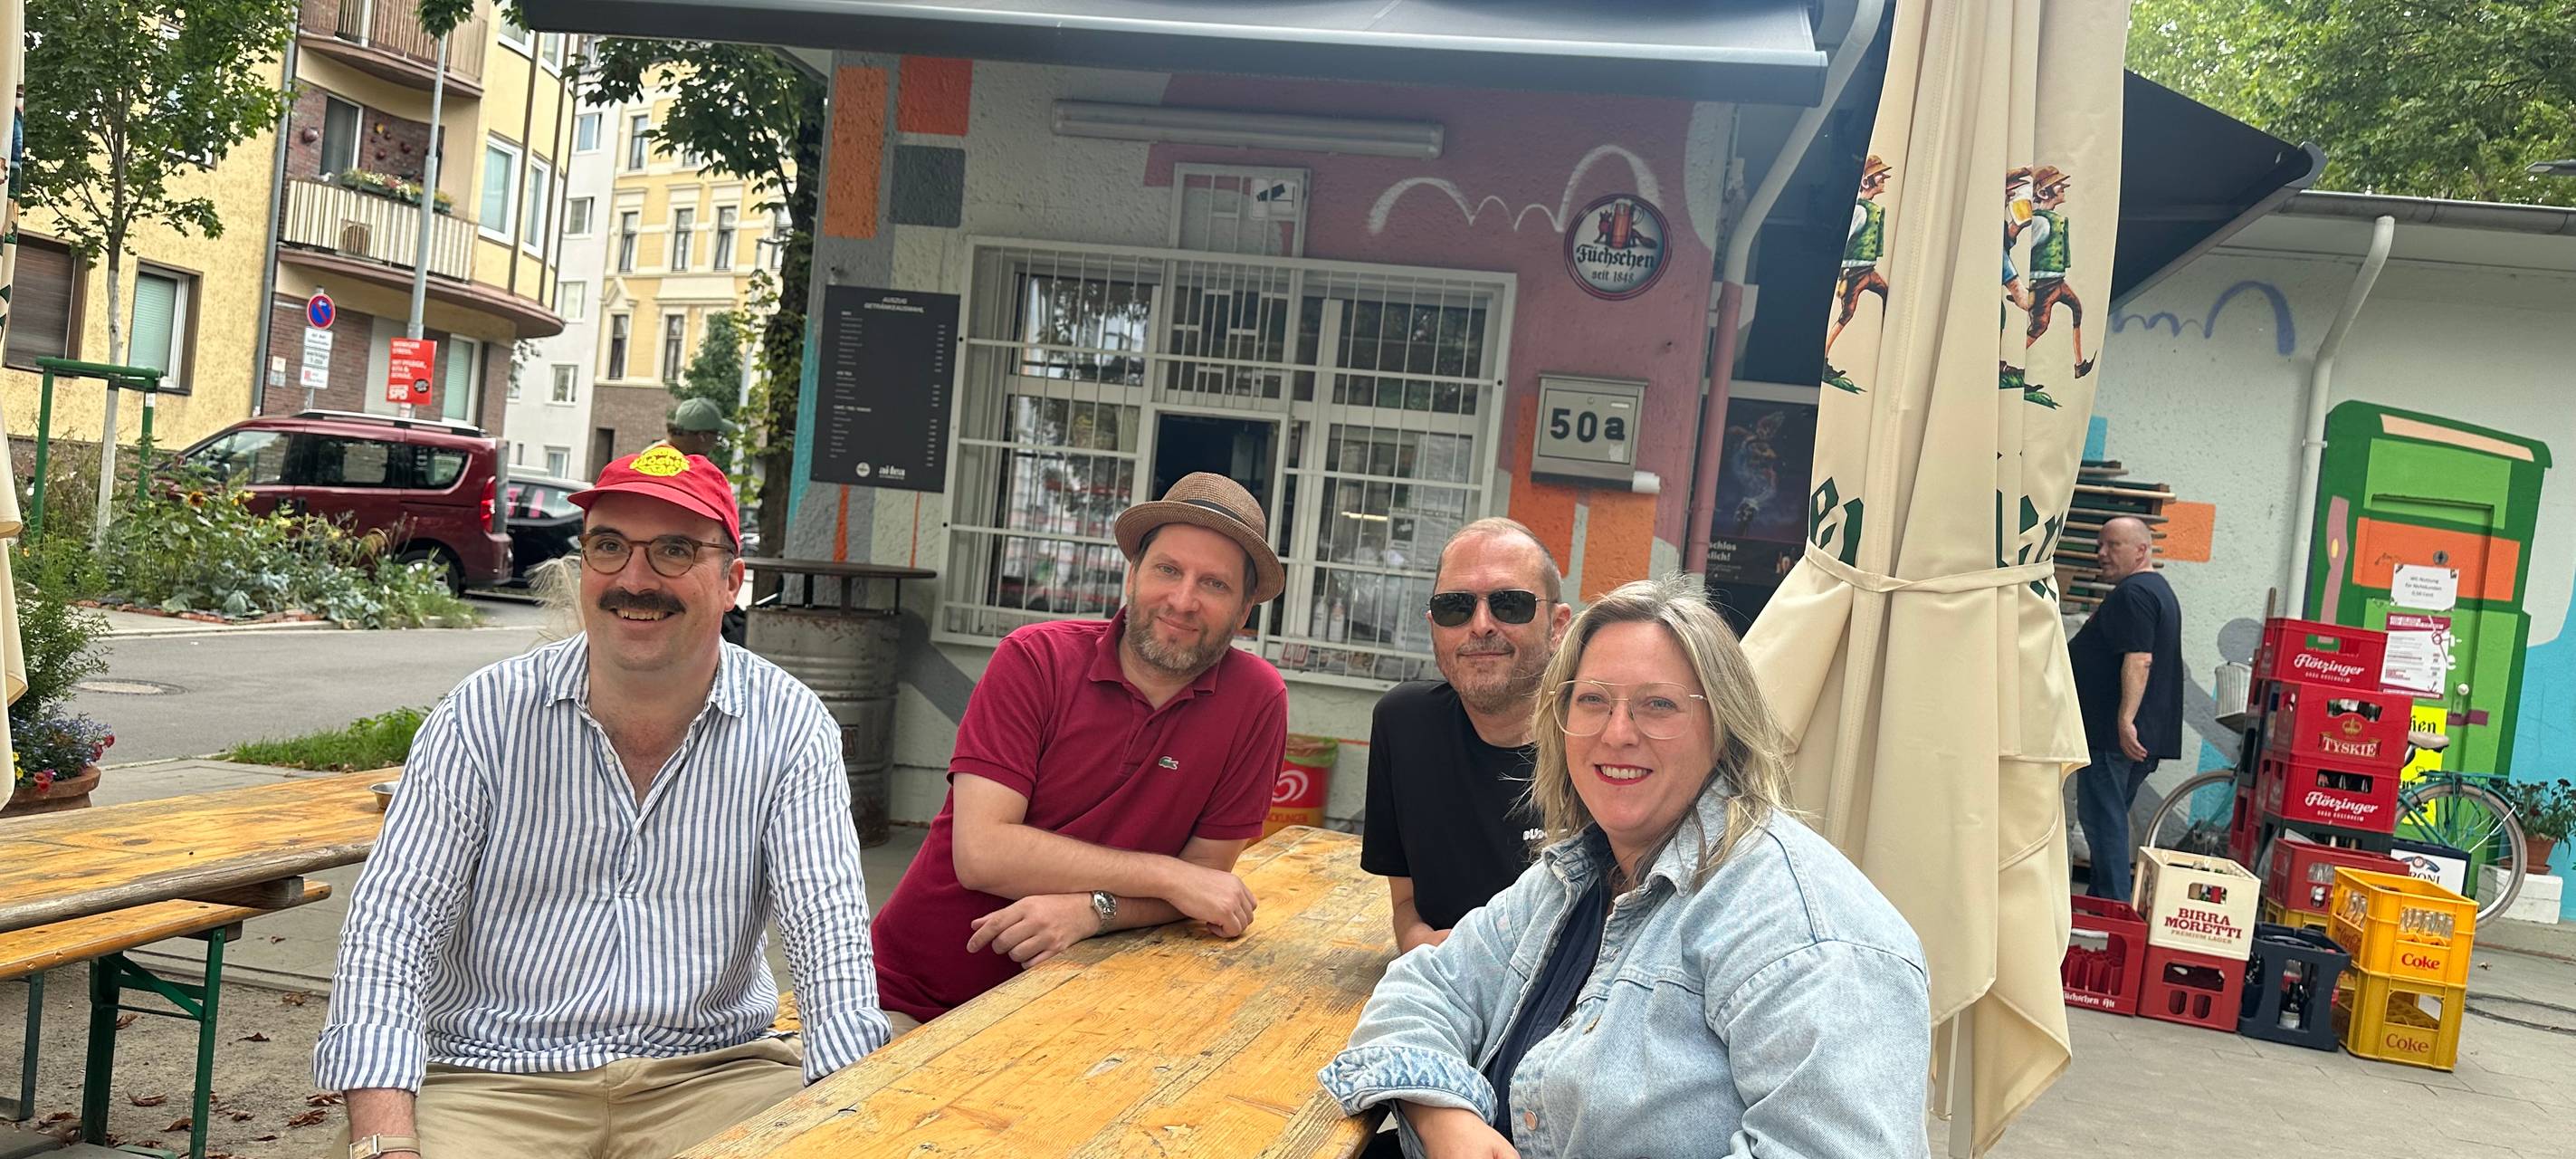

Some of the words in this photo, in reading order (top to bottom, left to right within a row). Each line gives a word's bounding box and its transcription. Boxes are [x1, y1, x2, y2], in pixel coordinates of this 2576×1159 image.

[1576, 244, 1655, 270] Füchschen
[1591, 270, 1609, 282] seit
[1613, 271, 1636, 283] 1848
[388, 389, 408, 399] SPD
[1550, 407, 1626, 444] 50a
[2294, 653, 2365, 677] Flötzinger
[2322, 735, 2378, 758] TYSKIE
[2304, 791, 2378, 815] Flötzinger
[2409, 871, 2440, 885] RONI
[2178, 907, 2230, 925] BIRRA
[2164, 915, 2242, 939] MORETTI
[2171, 929, 2207, 940] PREMIUM
[2208, 935, 2233, 944] LAGER
[2401, 953, 2440, 970] Coke
[2065, 991, 2100, 1005] üchschen
[2386, 1033, 2429, 1053] Coke
